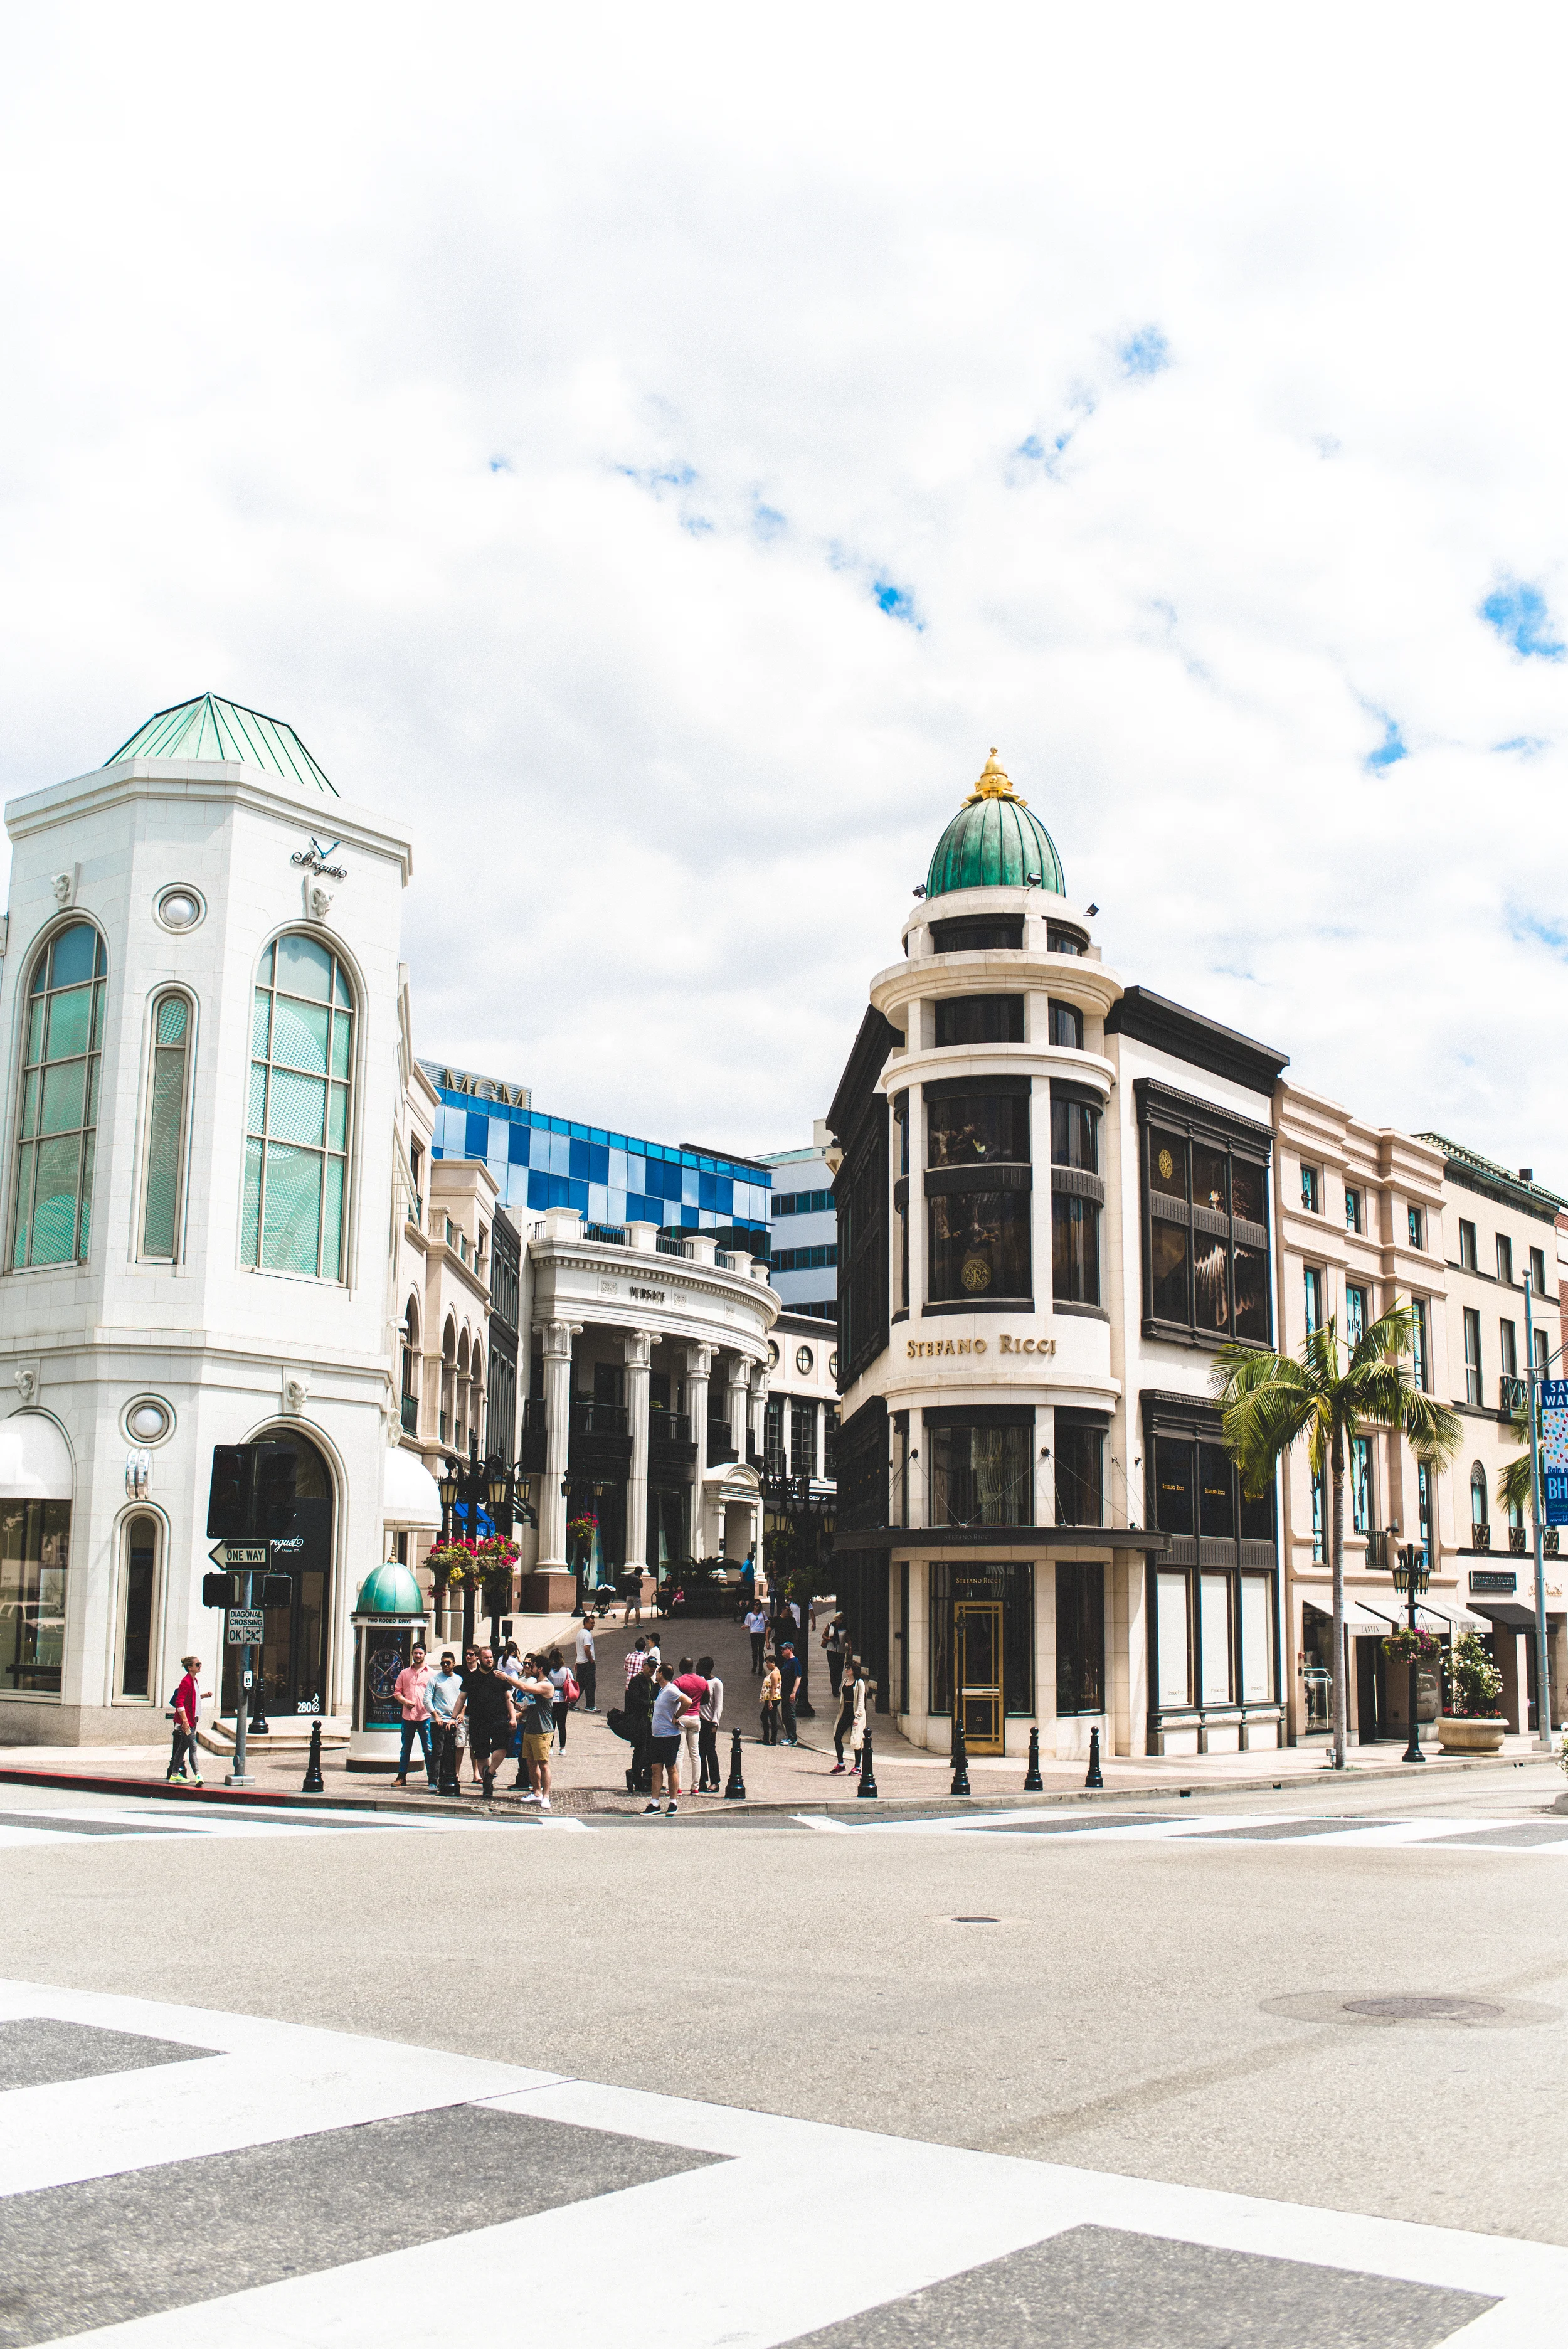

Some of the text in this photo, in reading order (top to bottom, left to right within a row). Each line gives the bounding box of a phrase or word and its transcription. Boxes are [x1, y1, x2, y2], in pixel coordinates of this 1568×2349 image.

[292, 851, 347, 878] Breguet
[444, 1068, 528, 1108] MGM
[630, 1286, 666, 1302] VERSACE
[906, 1334, 1057, 1357] STEFANO RICCI
[1550, 1382, 1568, 1393] SA
[270, 1534, 304, 1552] reguet
[226, 1549, 263, 1561] ONE WAY
[229, 1630, 241, 1641] OK
[1361, 1625, 1380, 1633] LANVIN
[297, 1702, 312, 1713] 280
